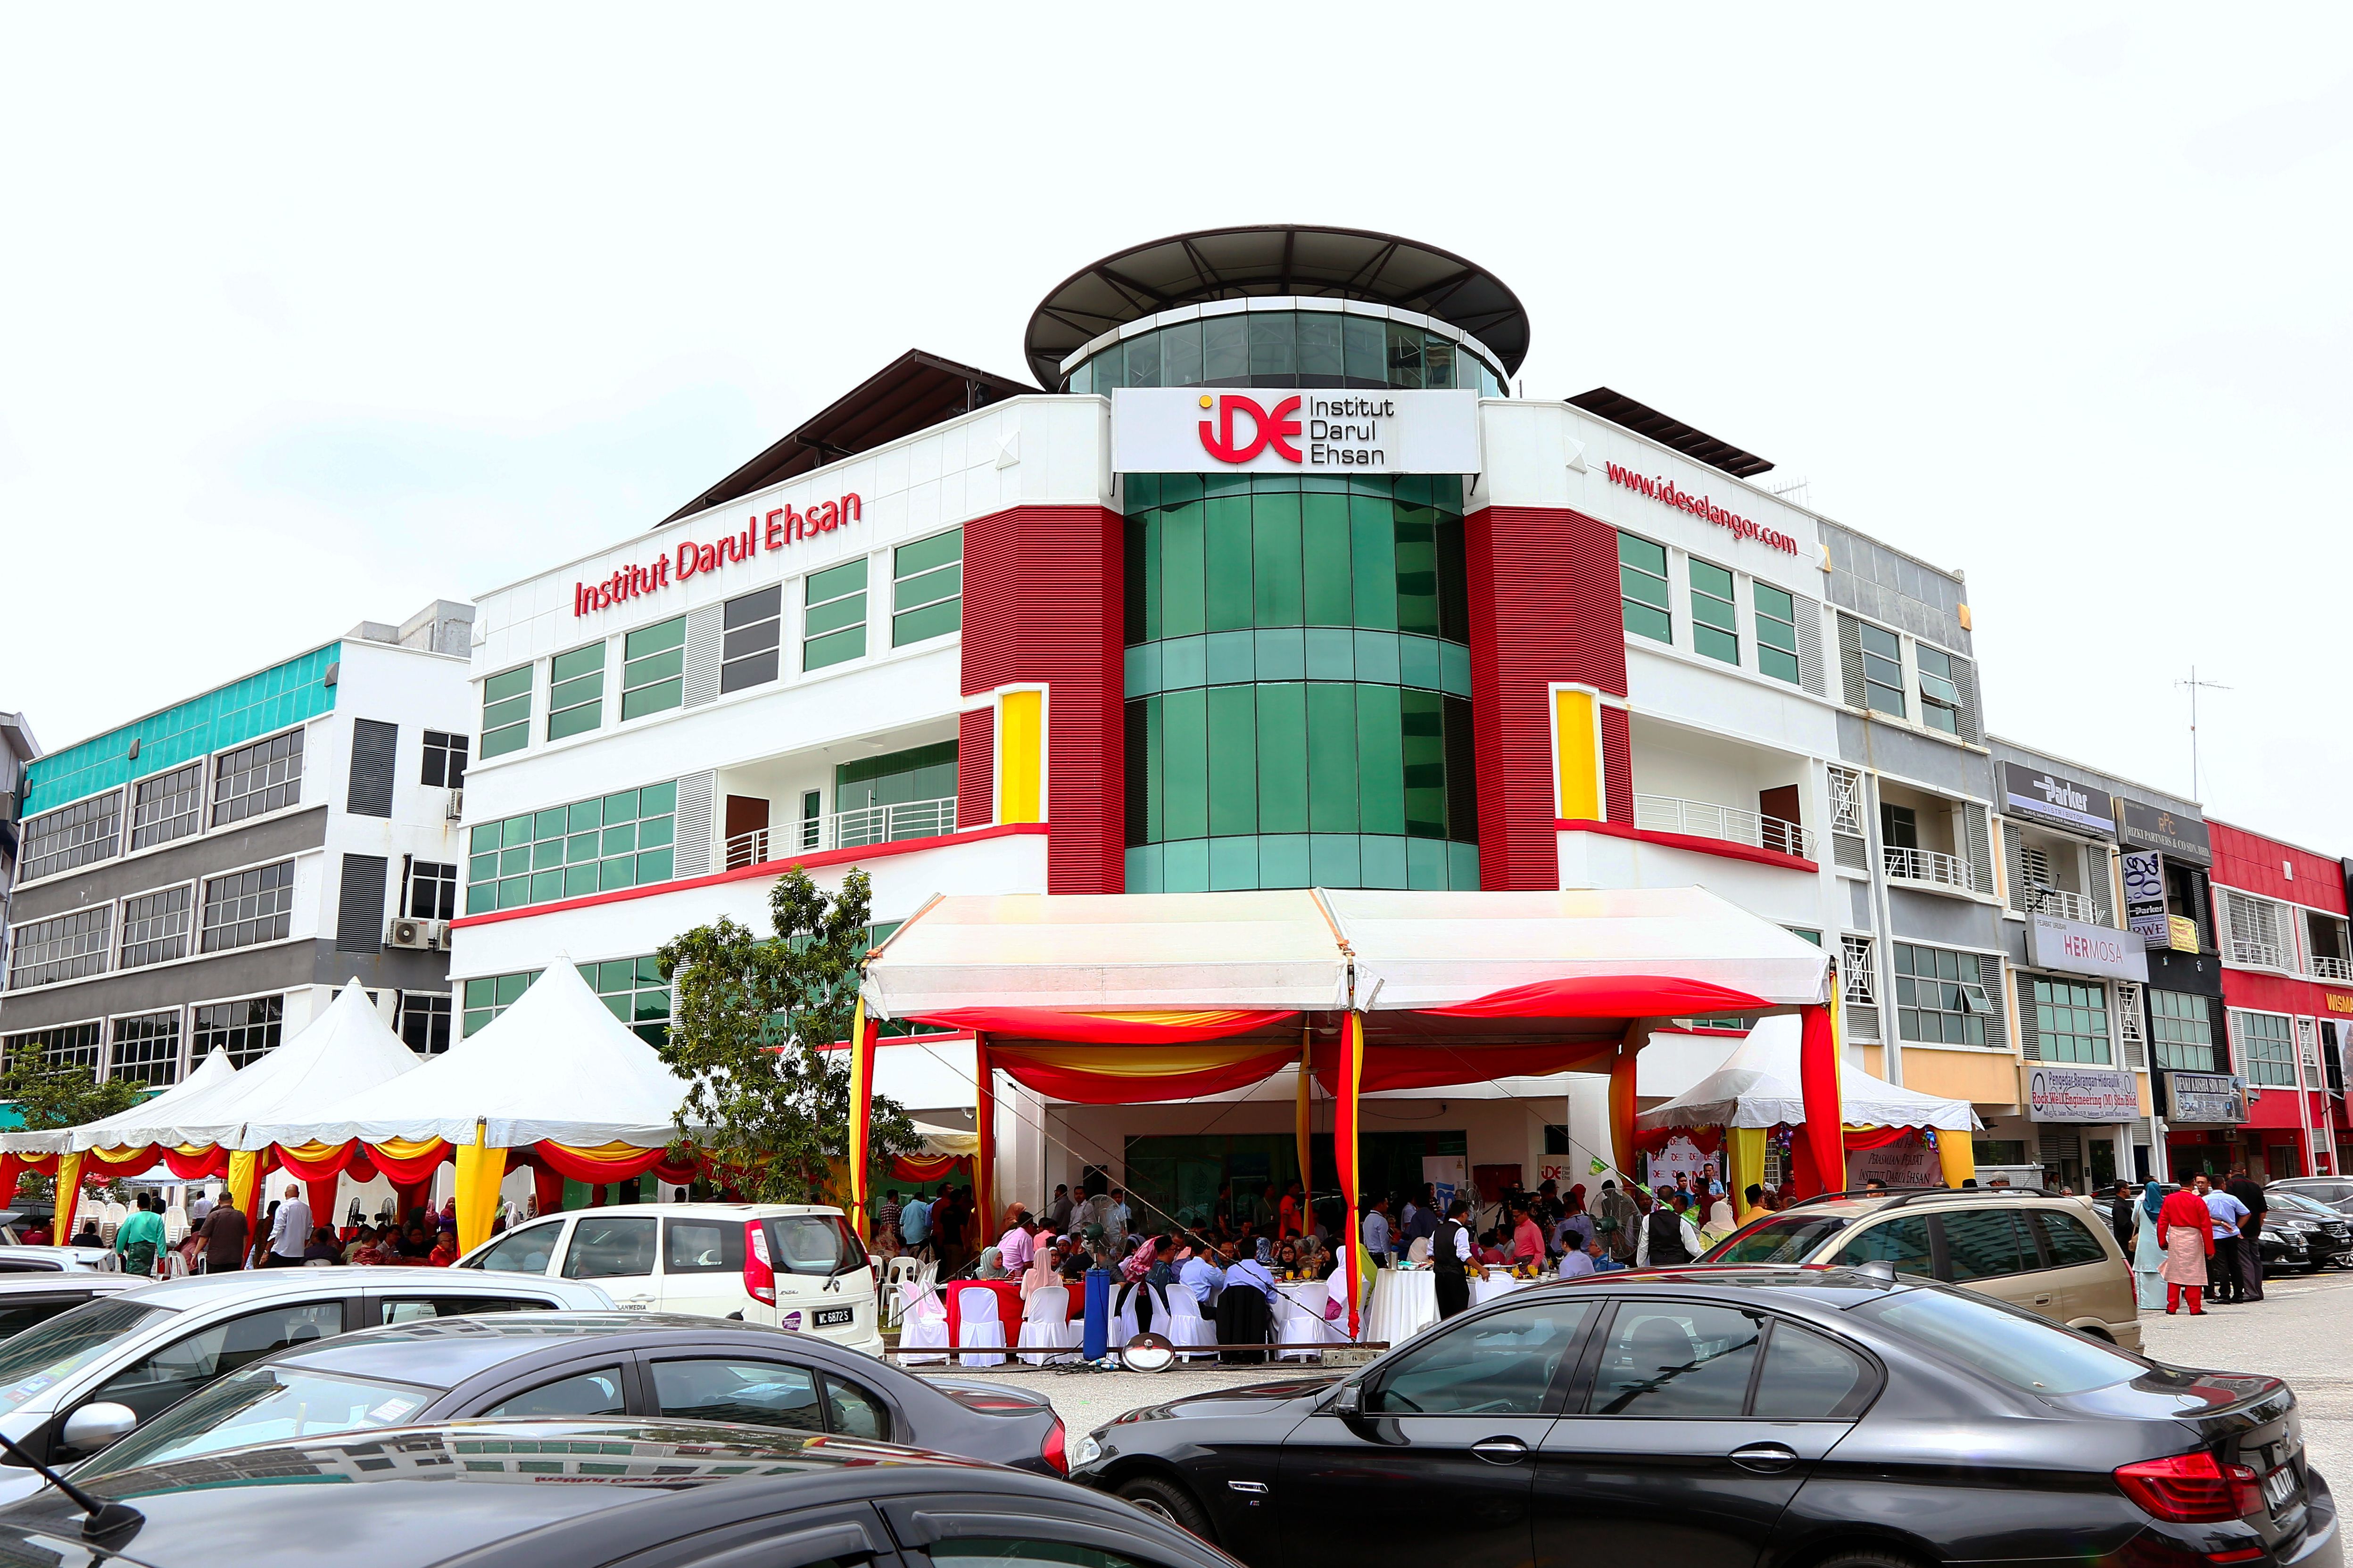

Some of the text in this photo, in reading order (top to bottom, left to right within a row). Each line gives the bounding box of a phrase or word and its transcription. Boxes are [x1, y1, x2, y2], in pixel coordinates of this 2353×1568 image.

[1310, 395, 1394, 418] Institut
[1310, 420, 1375, 441] Darul
[1310, 444, 1385, 465] Ehsan
[1606, 460, 1798, 556] www.ideselangor.com
[574, 492, 861, 617] Institut Darul Ehsan
[2033, 776, 2088, 812] Parker
[2043, 805, 2084, 821] DISTRIBUTOR
[2127, 826, 2144, 839] RIZKI
[2145, 830, 2172, 847] PARTNERS
[2172, 838, 2178, 848] &
[2178, 840, 2186, 850] CO
[2186, 842, 2198, 854] SDN.
[2198, 846, 2211, 858] BHD.
[2129, 906, 2163, 915] Parker
[2037, 919, 2052, 928] PEJABAT
[2064, 934, 2123, 964] HERMOSA
[2049, 1071, 2120, 1090] Pengedar Barangan Hidraulik
[2192, 1078, 2209, 1093] KAISHA
[2032, 1091, 2137, 1109] Rock Well Engineering (M) Sdn Bhd
[1868, 1153, 1899, 1165] PERASMIAN
[1858, 1169, 1930, 1184] INSTITUT DARUL EHSAN
[828, 1311, 844, 1322] 6872
[844, 1311, 849, 1320] S
